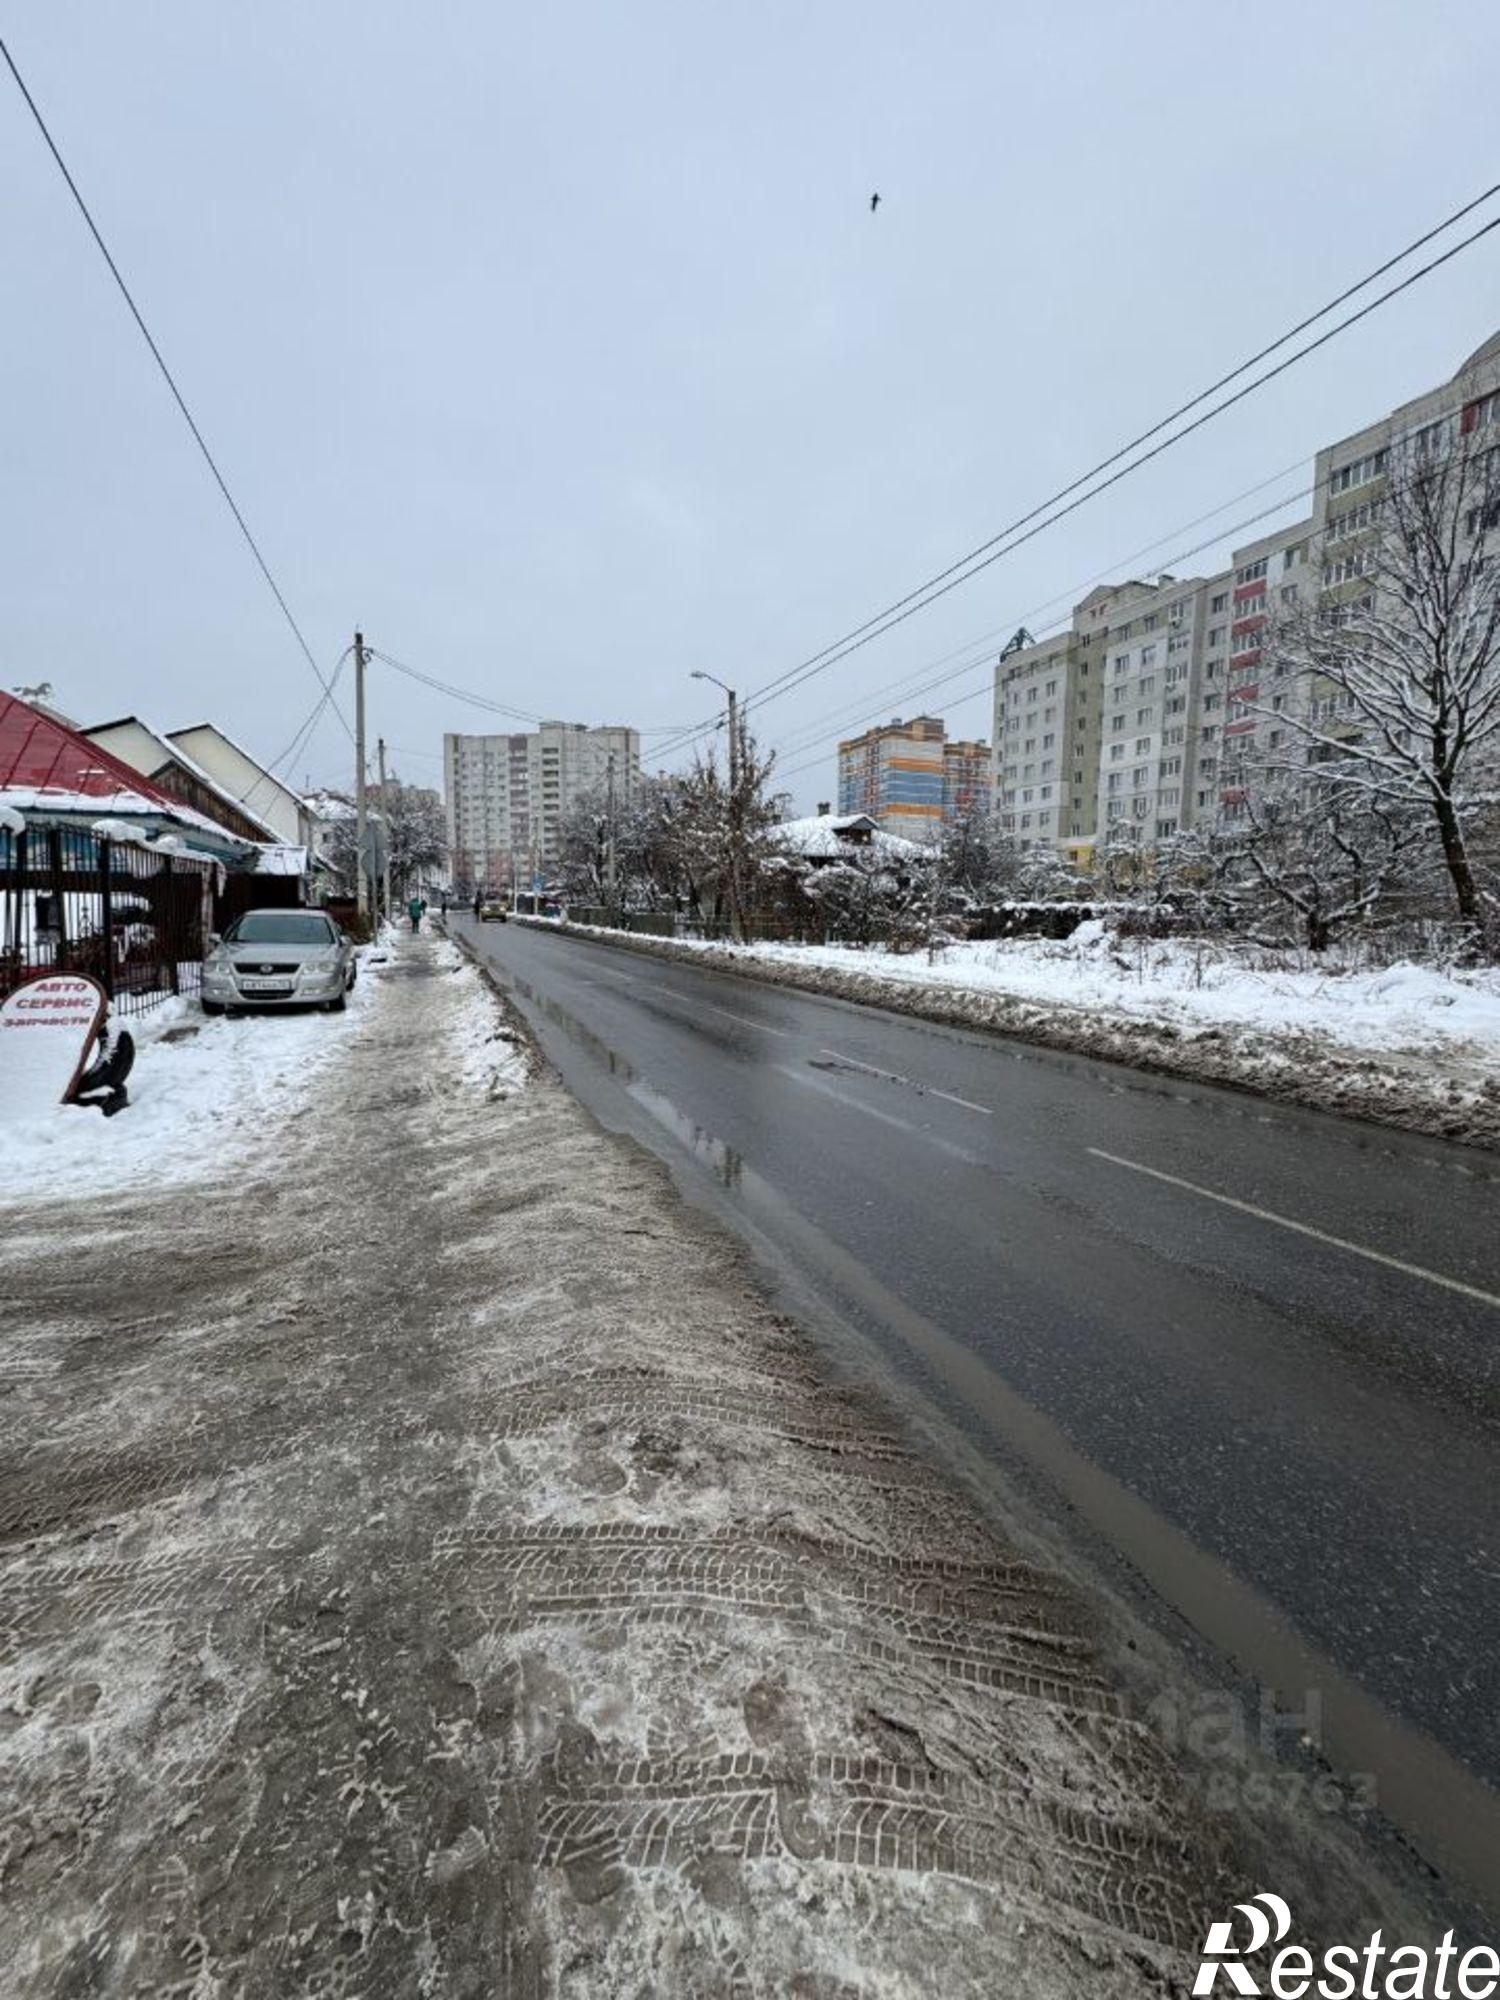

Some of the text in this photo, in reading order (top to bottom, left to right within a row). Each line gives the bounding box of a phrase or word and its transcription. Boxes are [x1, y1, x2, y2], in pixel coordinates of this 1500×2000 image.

[34, 982, 88, 992] АВТО
[15, 997, 94, 1009] СЕРВИС
[3, 1015, 90, 1027] ЗАПЧАСТИ
